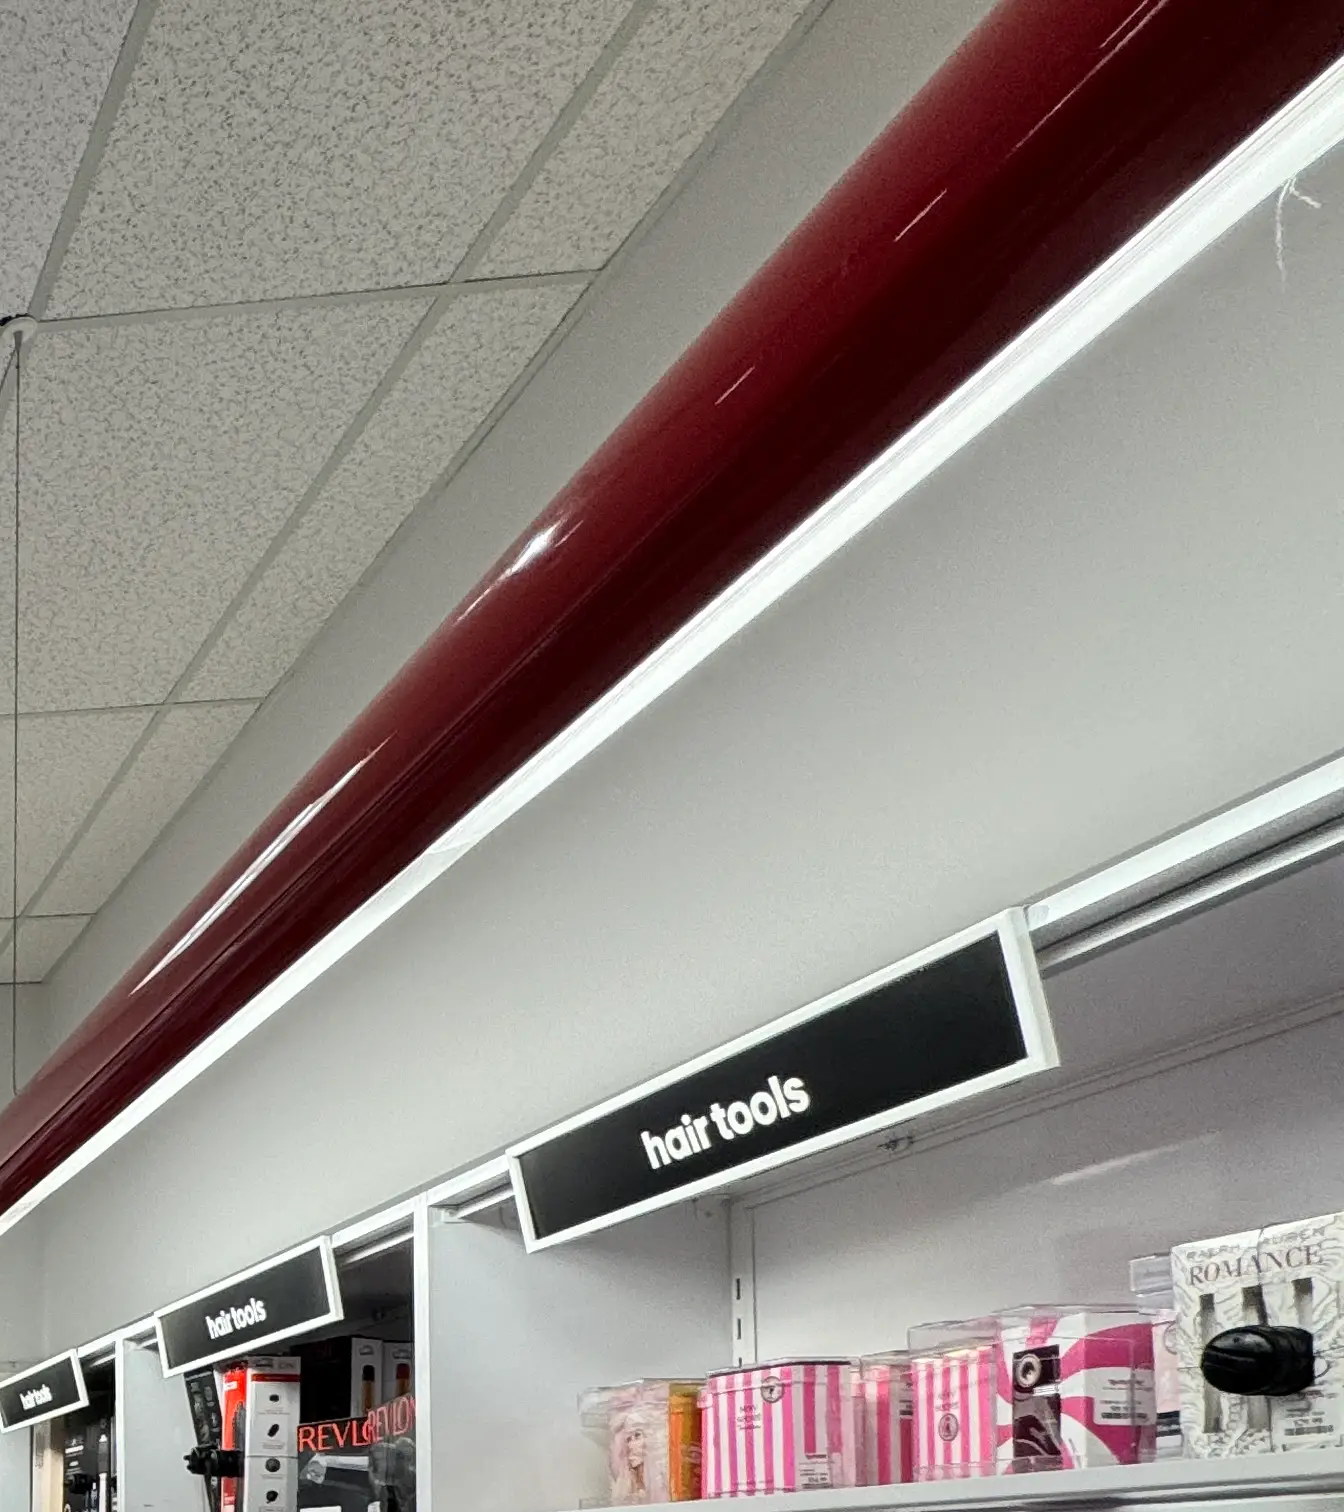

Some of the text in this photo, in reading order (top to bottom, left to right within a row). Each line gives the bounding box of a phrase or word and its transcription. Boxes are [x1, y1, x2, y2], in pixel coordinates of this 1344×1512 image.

[640, 1075, 812, 1171] hair tools
[1188, 1244, 1325, 1287] ROMANCE
[205, 1297, 267, 1341] hair tools
[19, 1391, 36, 1411] hair
